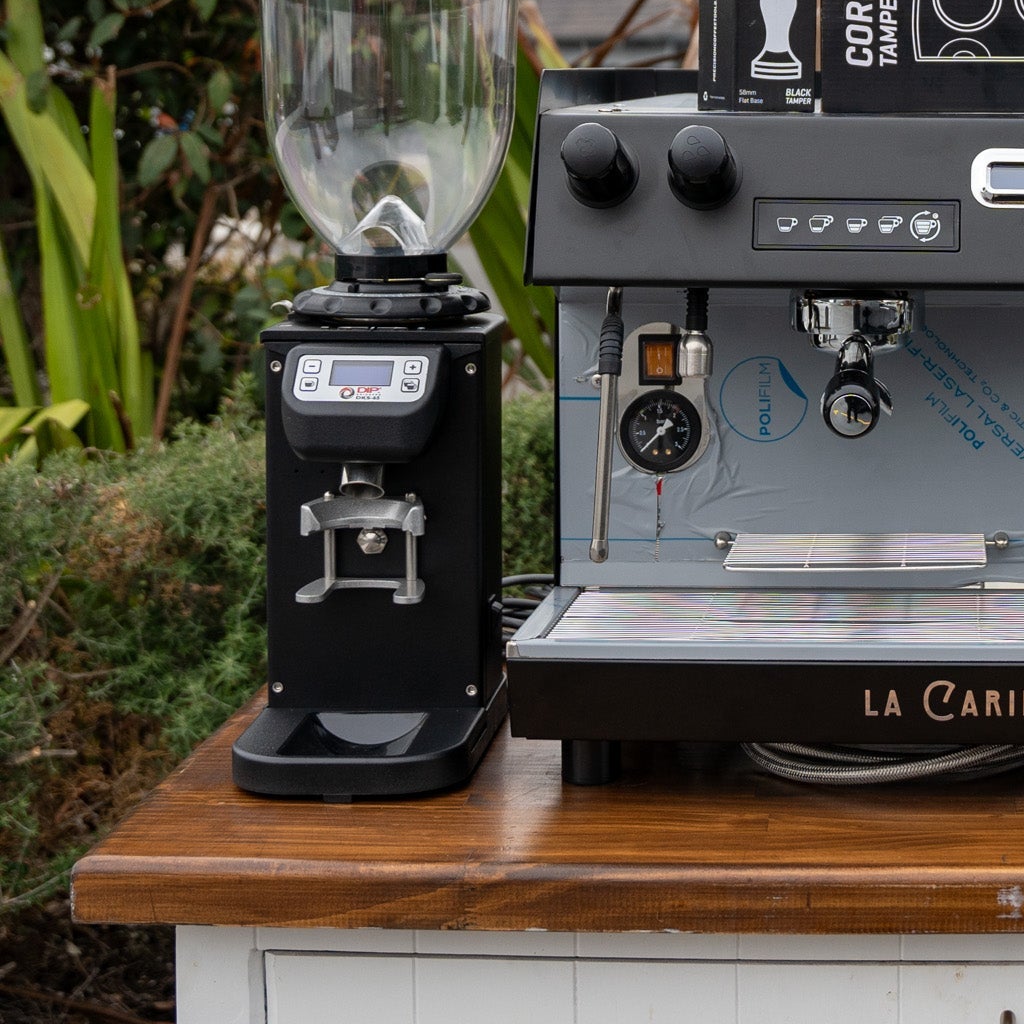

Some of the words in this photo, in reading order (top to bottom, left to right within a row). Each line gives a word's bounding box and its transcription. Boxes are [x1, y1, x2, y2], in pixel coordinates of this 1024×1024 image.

[738, 88, 757, 96] 58mm
[785, 87, 812, 97] BLACK
[785, 97, 812, 105] TAMPER
[921, 324, 977, 384] TECHNOLOG
[906, 336, 975, 408] LASER-FI
[759, 362, 772, 436] POLIFILM
[999, 402, 1009, 412] &
[924, 391, 986, 450] POLIFILM
[864, 689, 902, 717] LA
